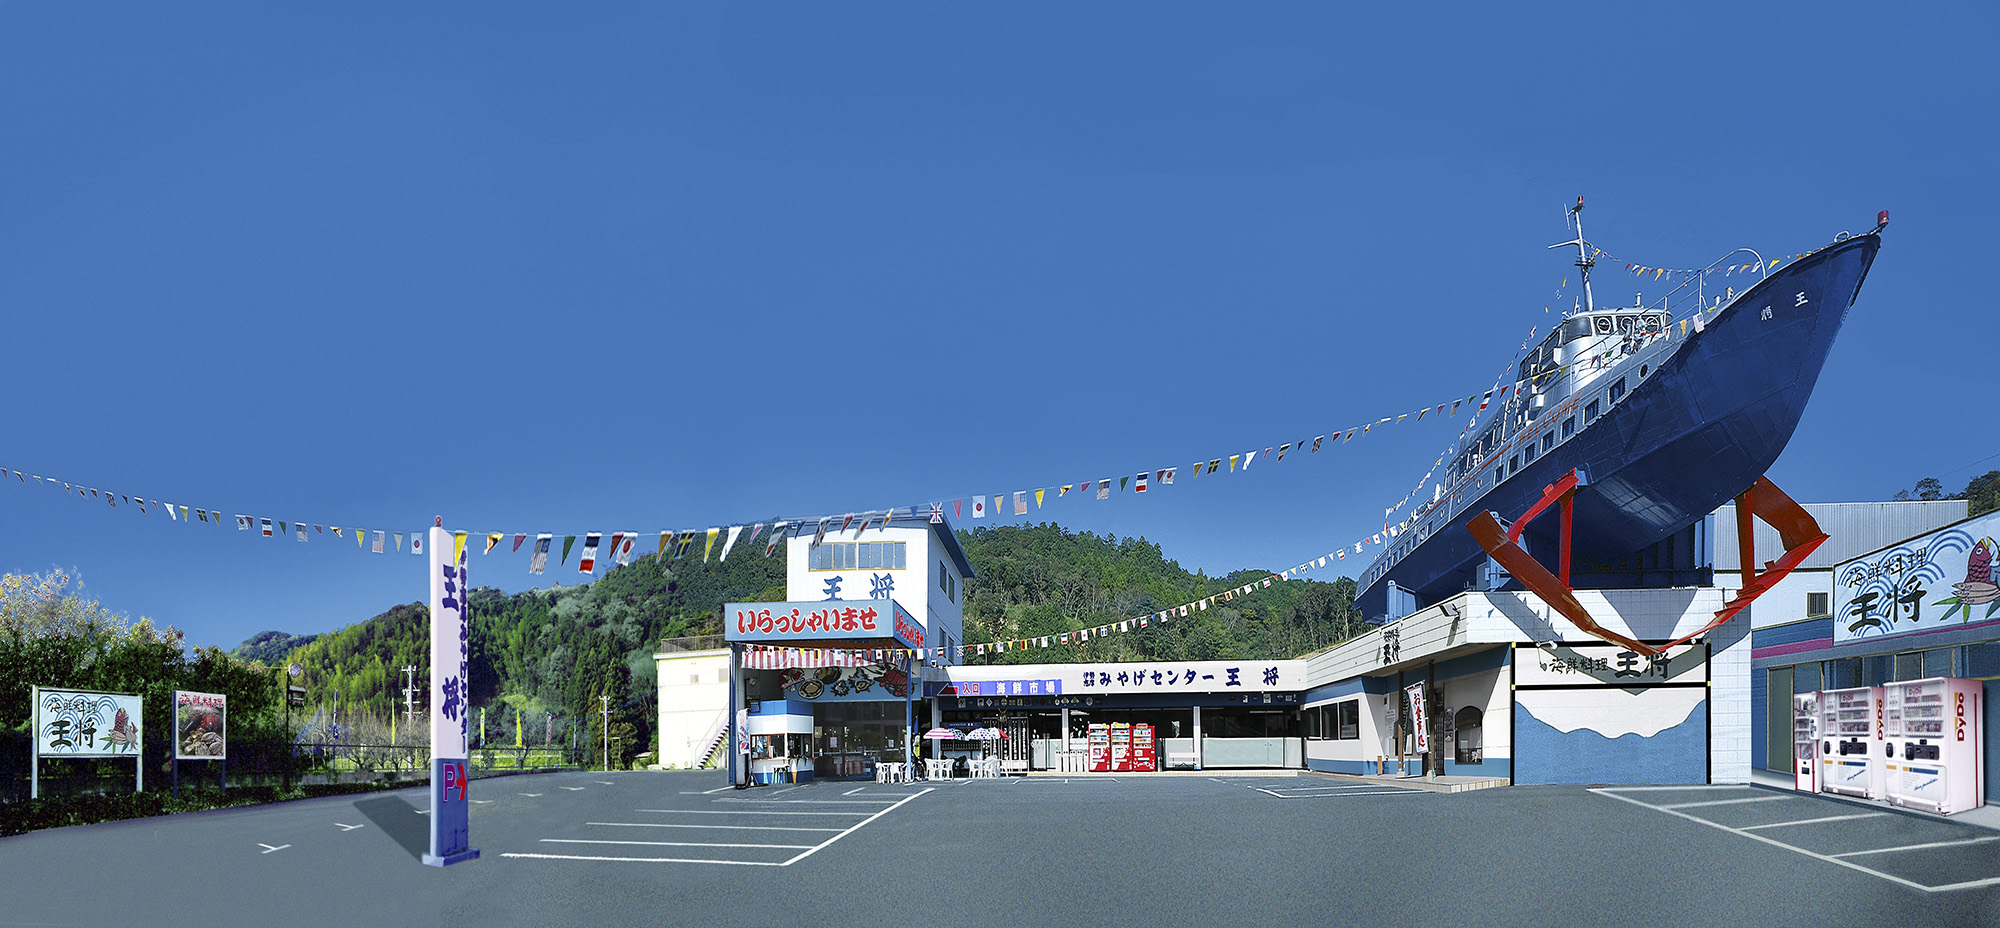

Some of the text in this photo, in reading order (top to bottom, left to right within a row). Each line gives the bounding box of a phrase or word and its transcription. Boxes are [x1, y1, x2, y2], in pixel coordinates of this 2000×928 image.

[1519, 390, 1583, 446] WELCOME
[1846, 547, 1927, 588] 海鮮料理
[821, 573, 895, 601] 王将
[1848, 575, 1927, 632] 王将
[737, 606, 878, 634] いらっしゃいませ
[442, 564, 460, 722] 王将
[1100, 667, 1280, 687] みやげセンター 王将
[1549, 651, 1671, 679] 海鮮料理 王将
[179, 694, 223, 709] 海鮮料理
[963, 683, 979, 694] 入口
[996, 682, 1056, 694] 海鮮市場
[50, 699, 98, 716] 海鮮料理
[1414, 693, 1426, 748] お食事処
[1957, 692, 1967, 741] DyDo
[50, 717, 97, 748] 王将
[443, 763, 456, 802] P
